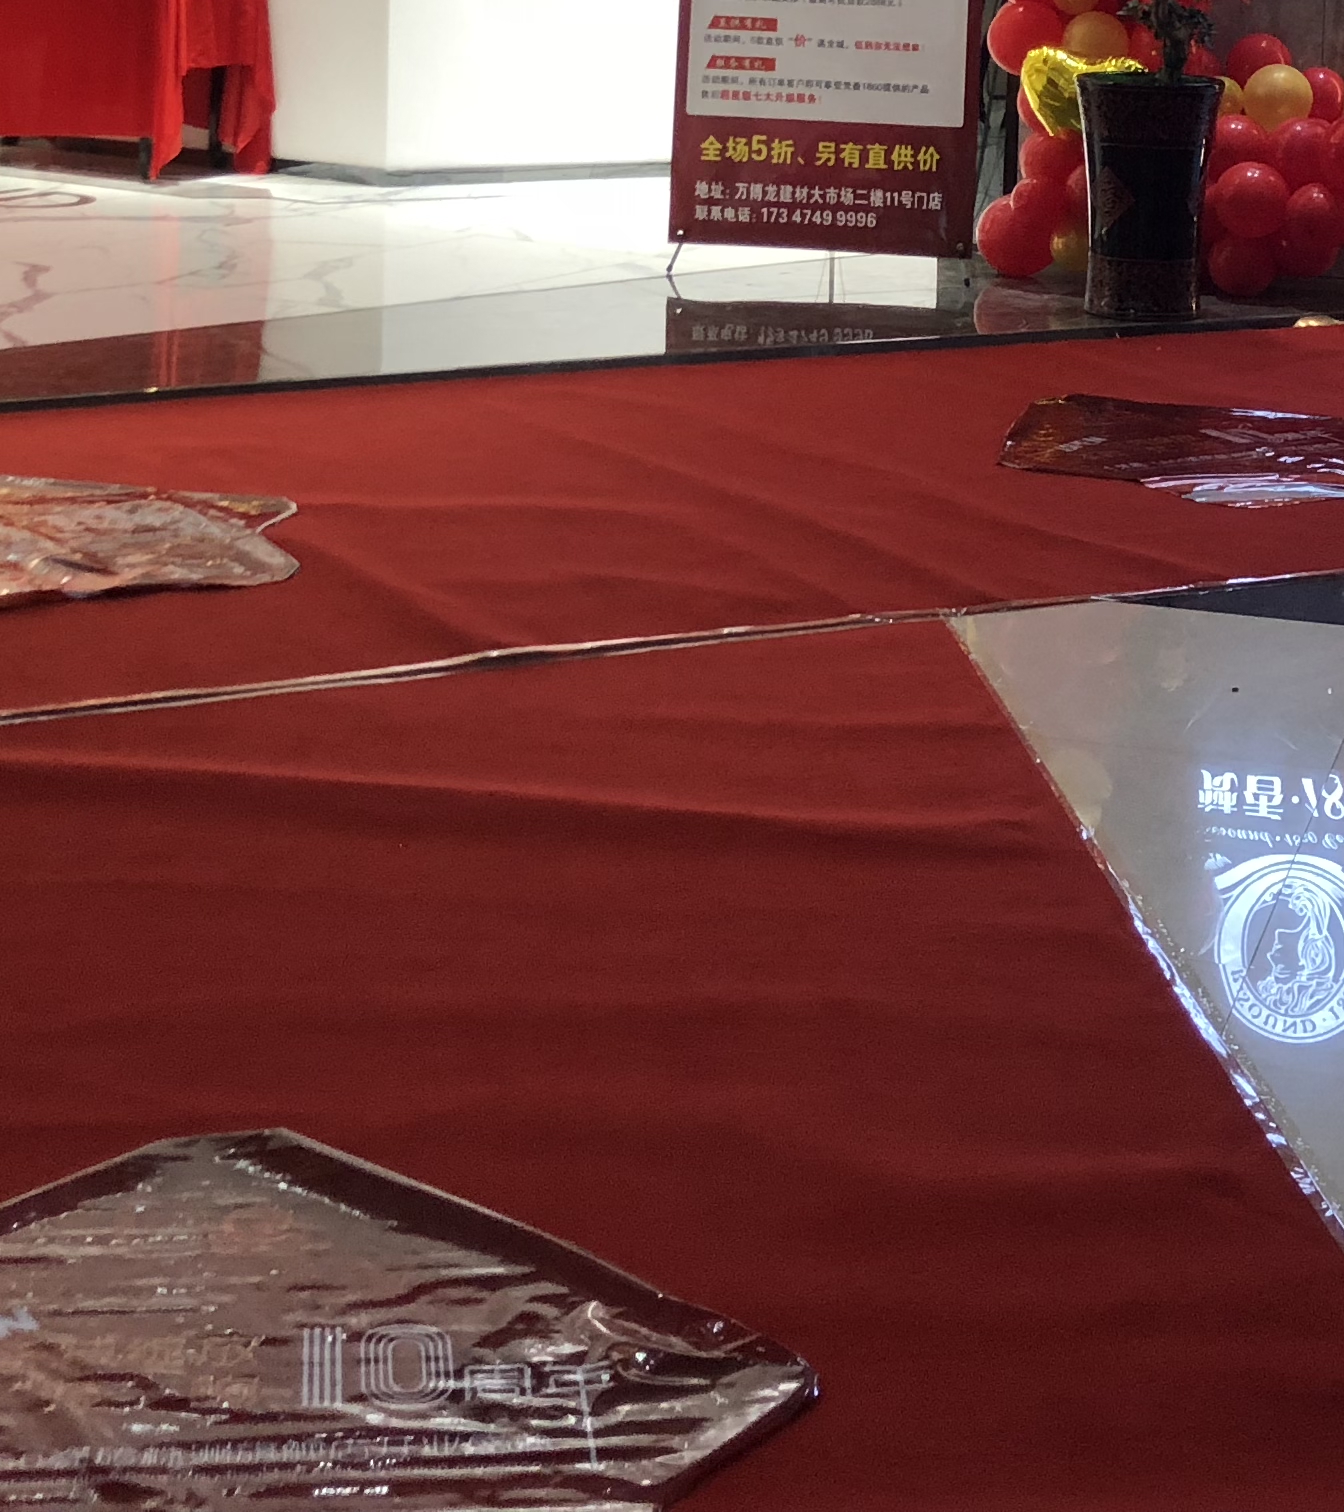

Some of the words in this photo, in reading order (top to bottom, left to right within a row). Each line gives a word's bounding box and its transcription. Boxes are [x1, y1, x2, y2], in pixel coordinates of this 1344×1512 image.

[699, 134, 941, 173] 全场5折、另有直供价
[761, 207, 787, 224] 173
[792, 209, 832, 226] 4749
[836, 211, 877, 228] 9996
